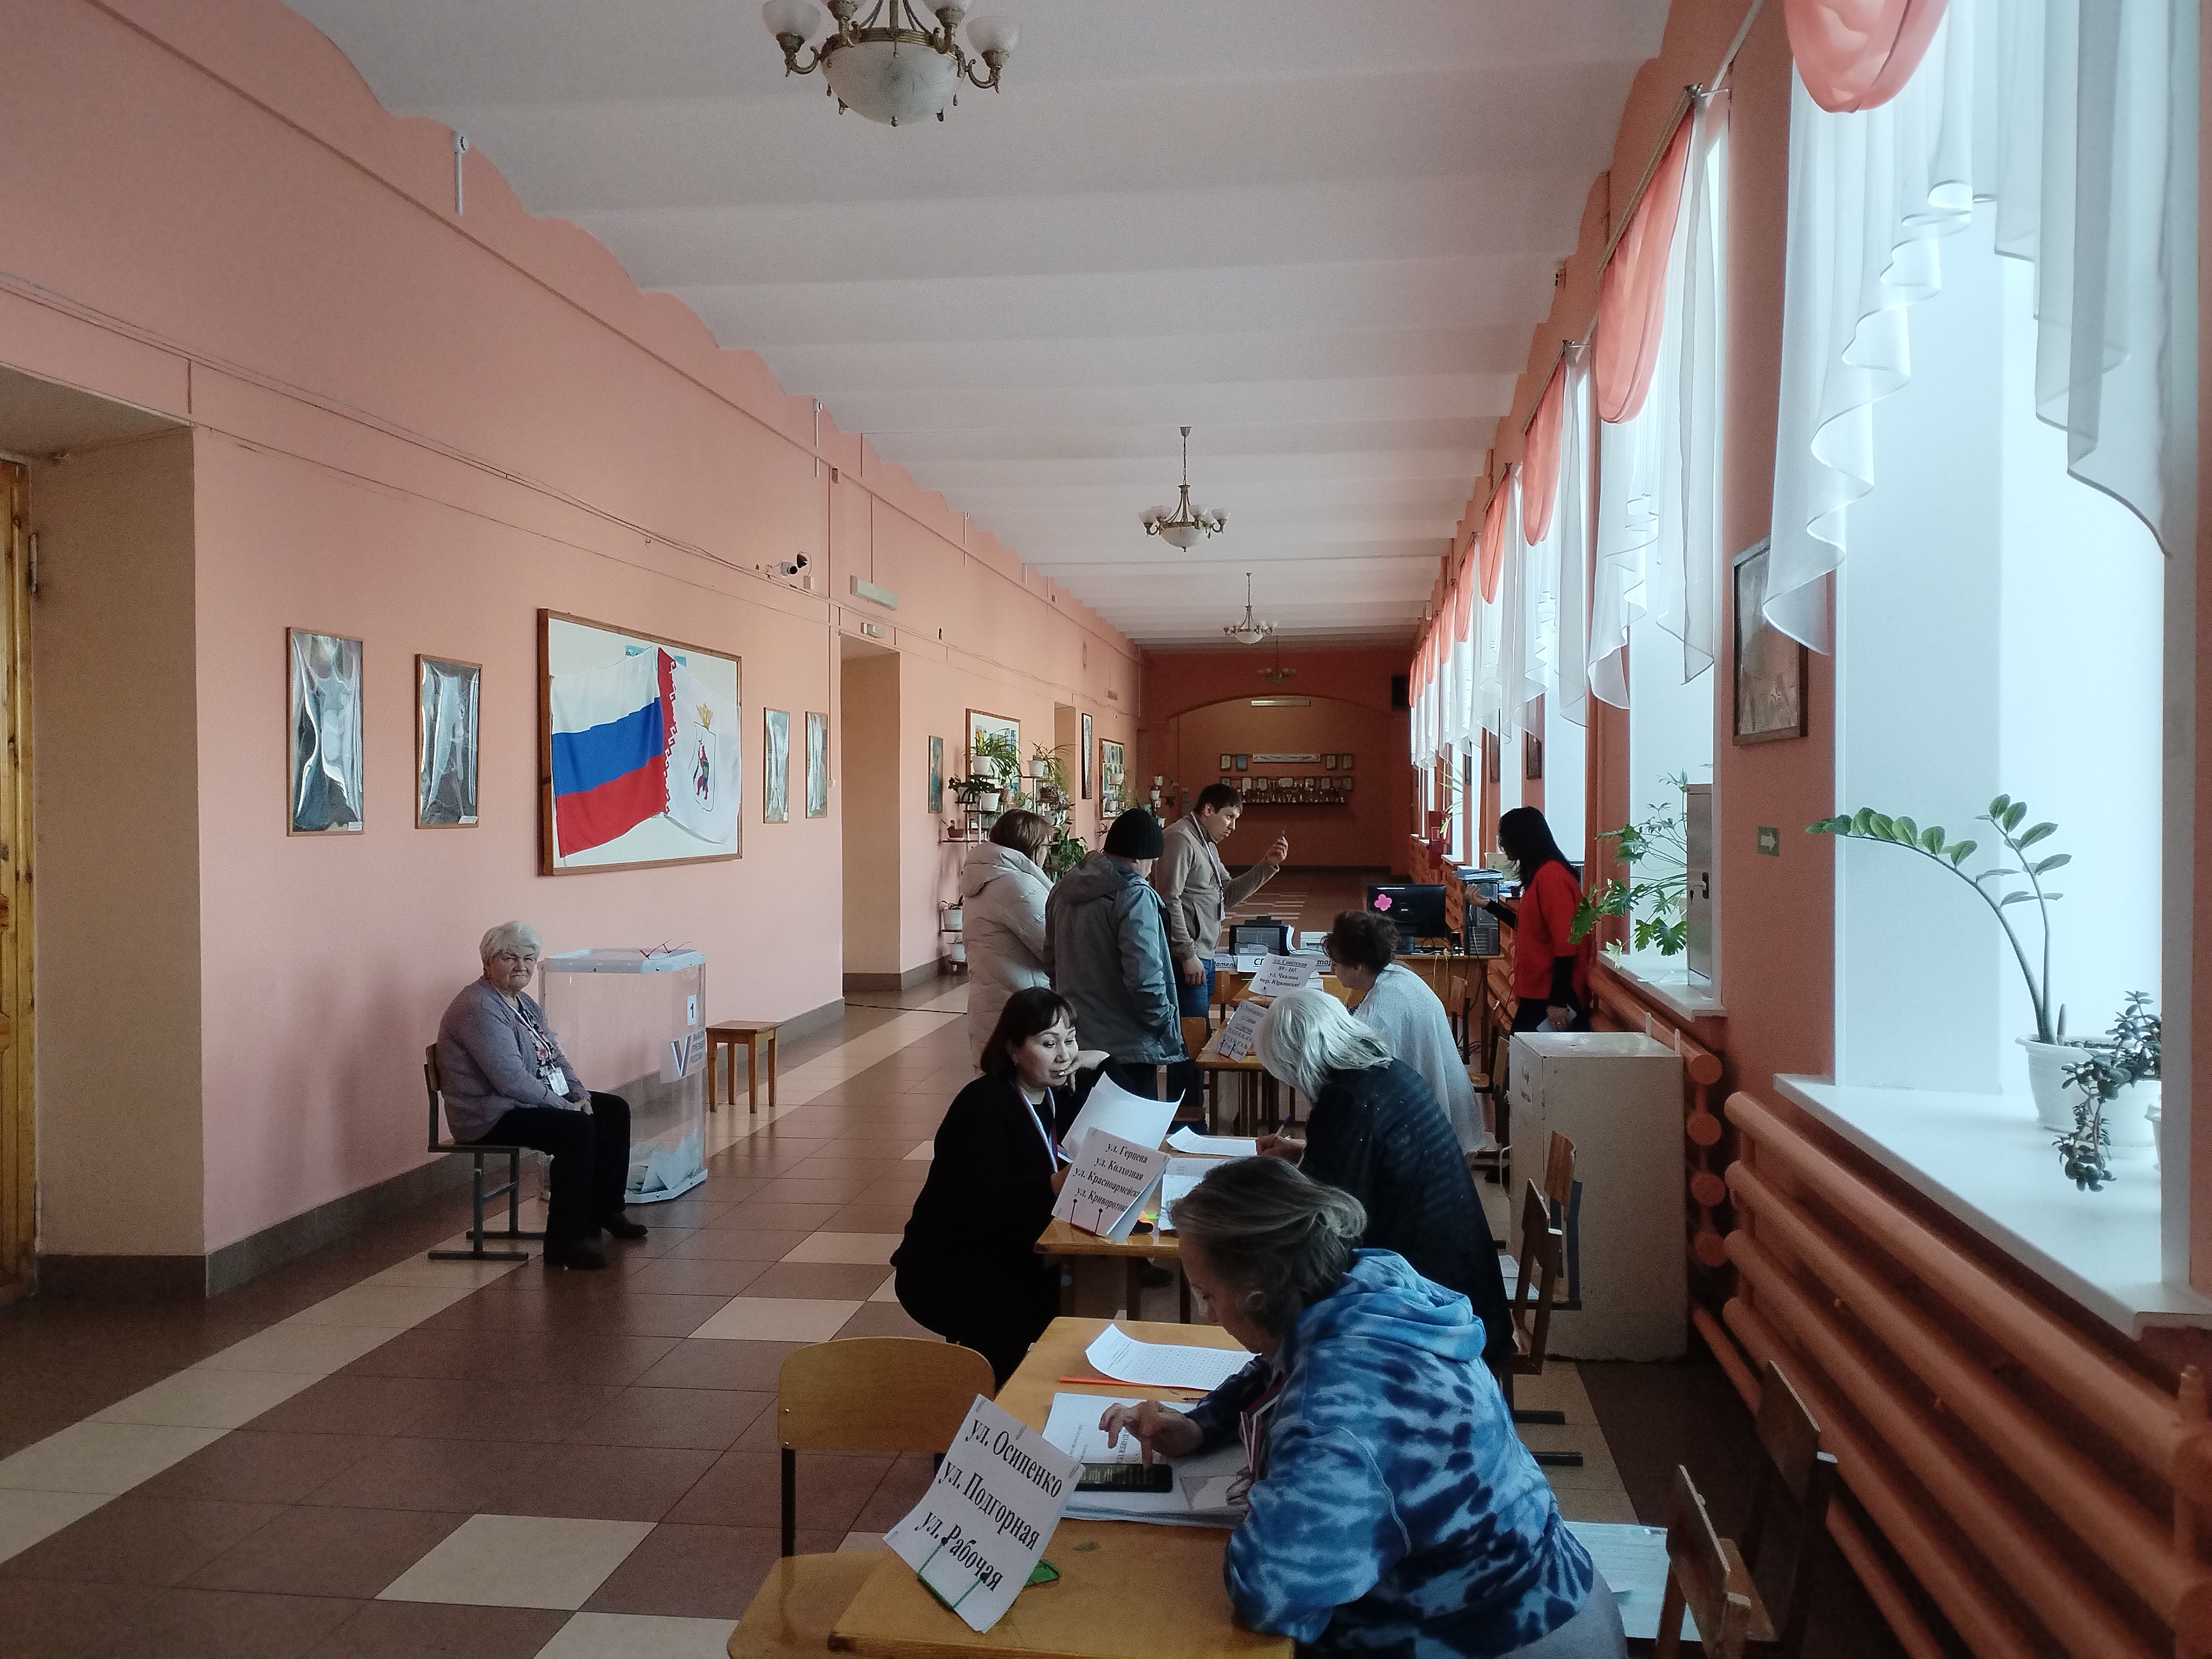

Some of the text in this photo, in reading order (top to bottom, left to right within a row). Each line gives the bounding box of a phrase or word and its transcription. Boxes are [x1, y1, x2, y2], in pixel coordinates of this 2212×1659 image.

[690, 1003, 693, 1019] 1
[1105, 1143, 1148, 1164] ул. Герцена
[1073, 1168, 1085, 1178] ул.
[1094, 1157, 1144, 1181] ул. Колхозная
[1075, 1188, 1087, 1198] ул.
[965, 1419, 990, 1447] ул.
[993, 1431, 1063, 1498] Осипенко
[938, 1460, 1041, 1552] ул. Подгорная
[914, 1511, 1003, 1592] ул. Рабочая
